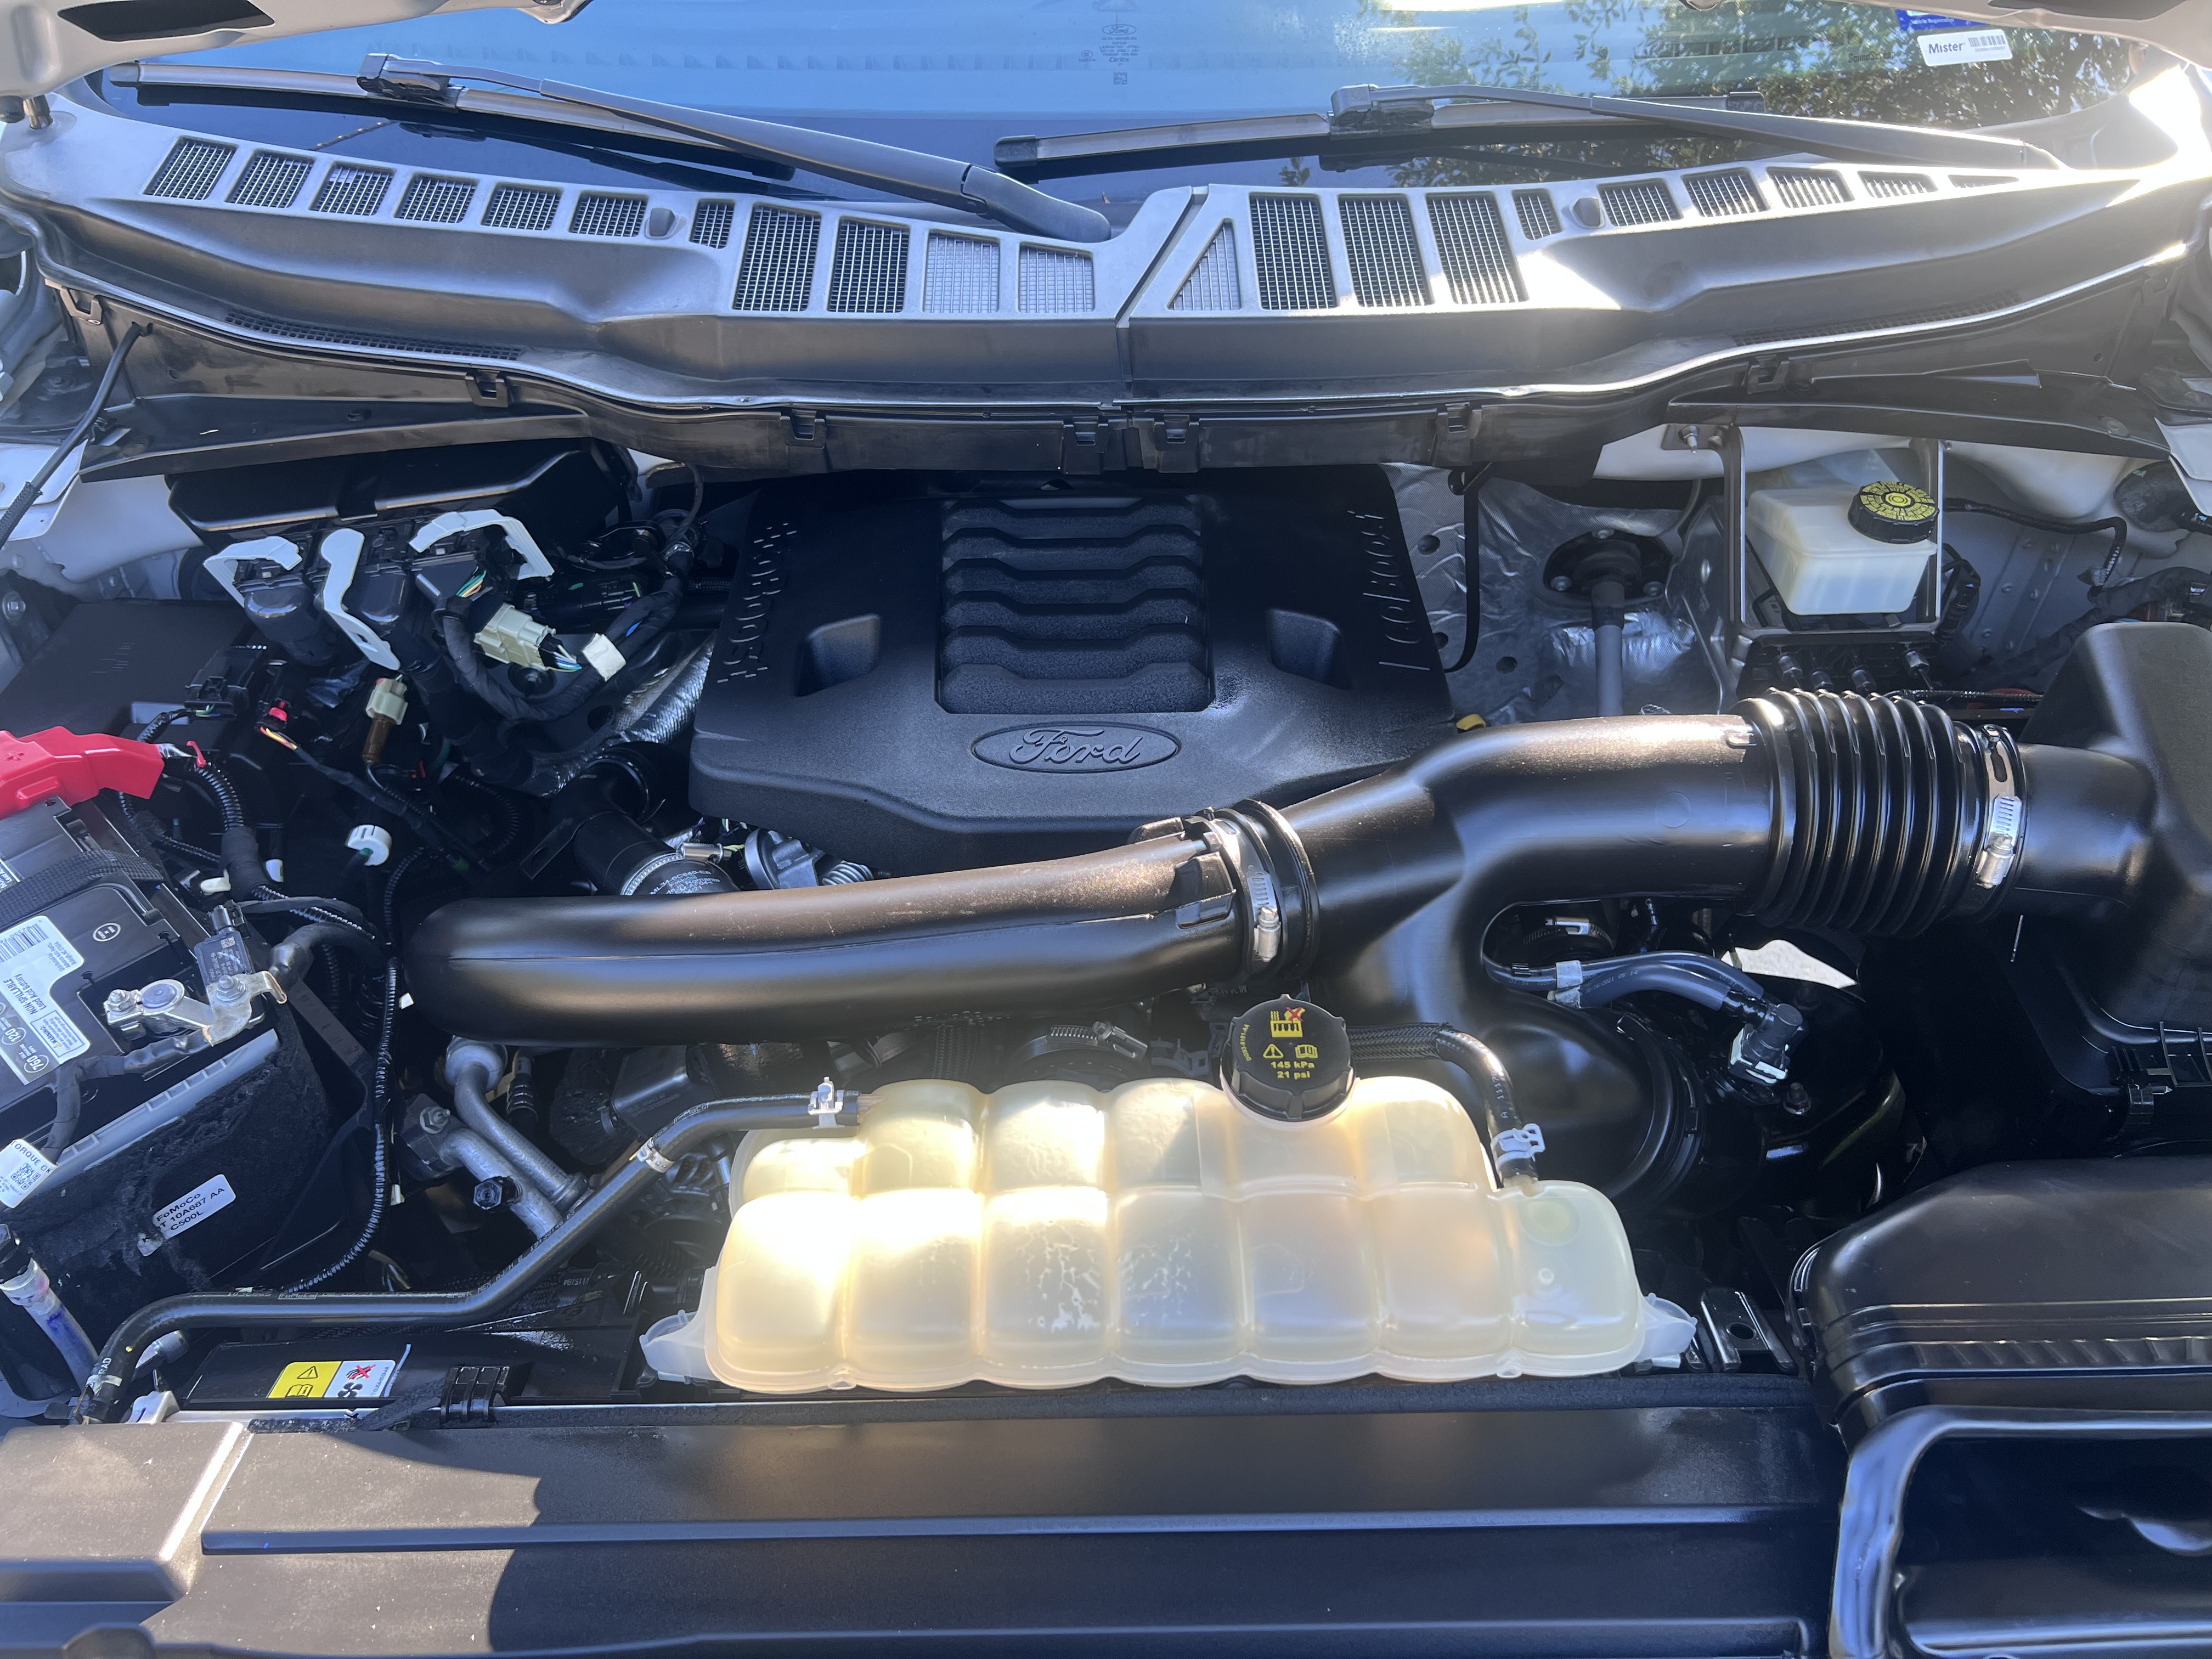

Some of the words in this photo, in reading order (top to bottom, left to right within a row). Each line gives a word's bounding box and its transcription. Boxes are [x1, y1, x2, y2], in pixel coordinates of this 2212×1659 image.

[1109, 26, 1129, 34] Ford
[1929, 42, 1966, 54] Mister
[1009, 728, 1141, 765] Ford
[14, 974, 30, 990] Battery
[3, 978, 38, 1015] NON-SPILLABLE
[25, 988, 38, 998] Acid
[32, 997, 47, 1011] Lead
[5, 1028, 21, 1042] 120
[26, 1055, 44, 1071] 760
[1294, 1070, 1311, 1080] psi
[11, 1141, 41, 1166] TORQUE
[41, 1165, 53, 1173] OK
[156, 1193, 201, 1222] FoMoCo
[170, 1198, 206, 1221] 10A687
[210, 1188, 225, 1199] AA
[171, 1211, 205, 1231] C500L
